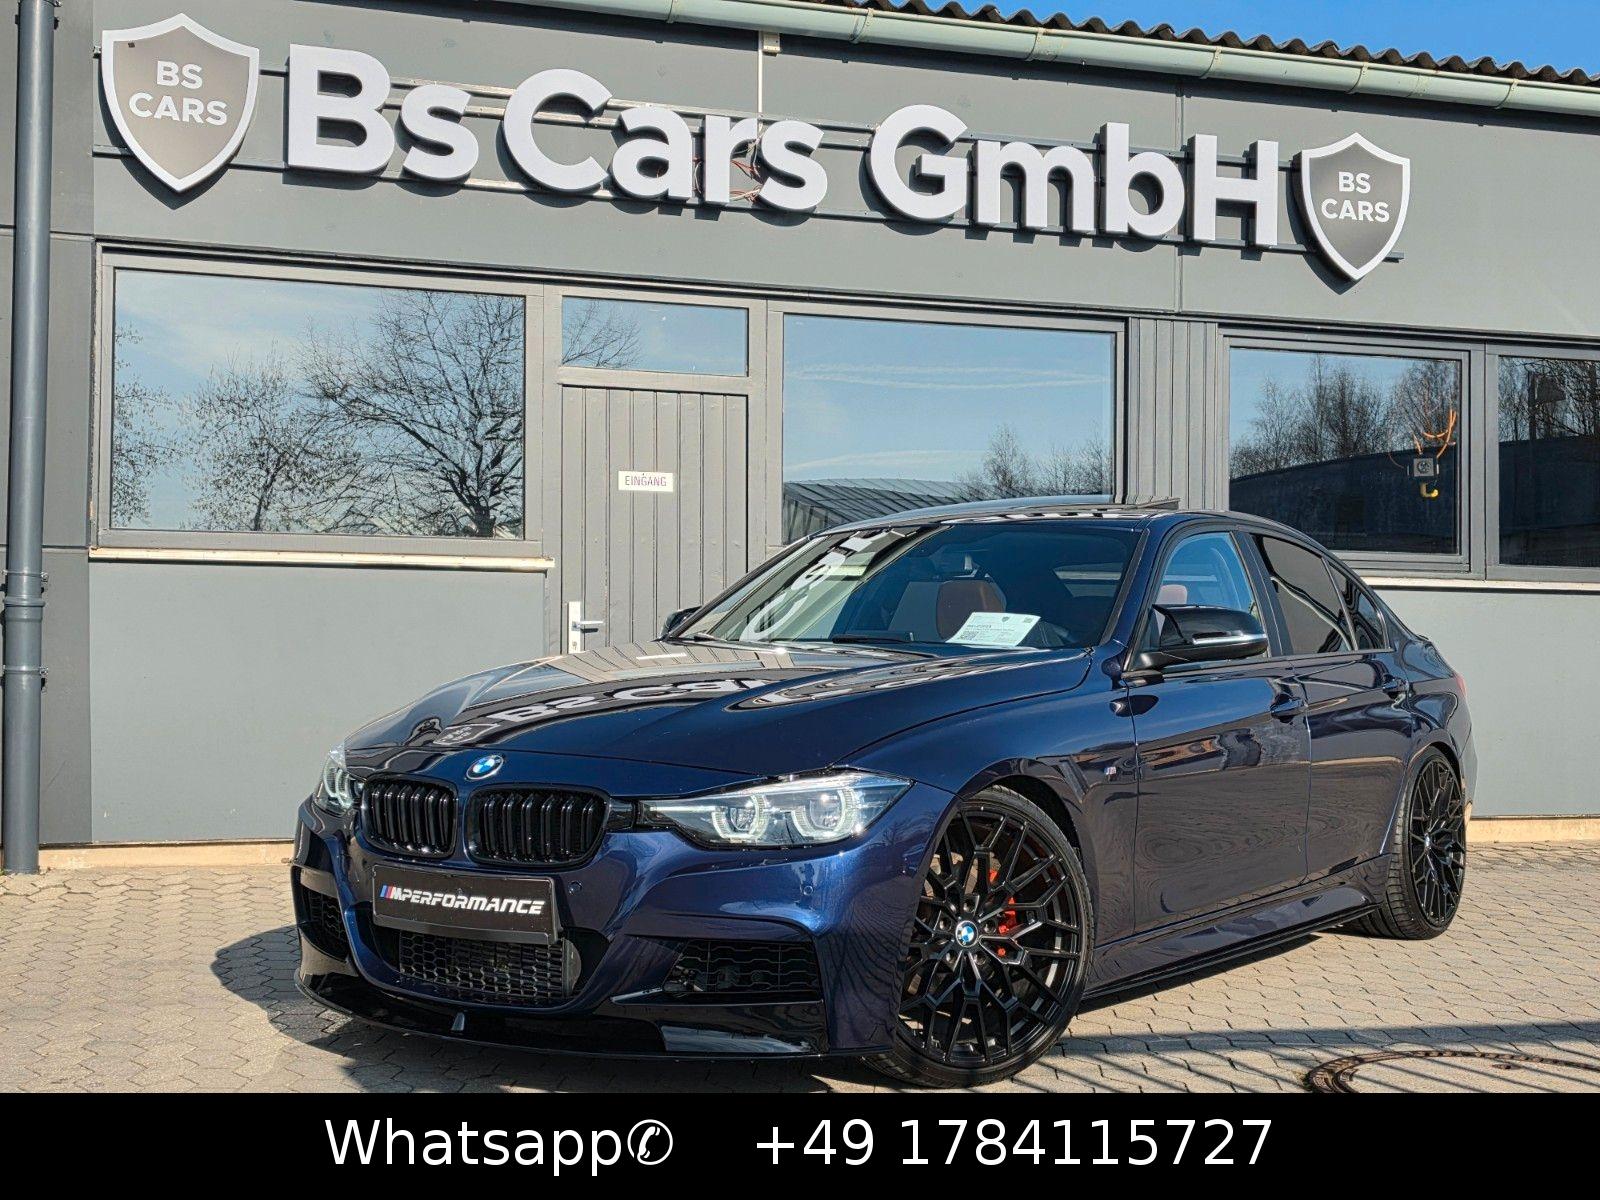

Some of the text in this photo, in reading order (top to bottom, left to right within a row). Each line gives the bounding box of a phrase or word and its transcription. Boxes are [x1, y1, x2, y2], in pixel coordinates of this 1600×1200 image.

[157, 61, 203, 89] BS
[129, 92, 227, 126] CARS
[288, 43, 1279, 248] Bs Cars GmbH
[1338, 171, 1371, 194] BS
[1321, 198, 1390, 222] CARS
[624, 475, 667, 487] EINGANG
